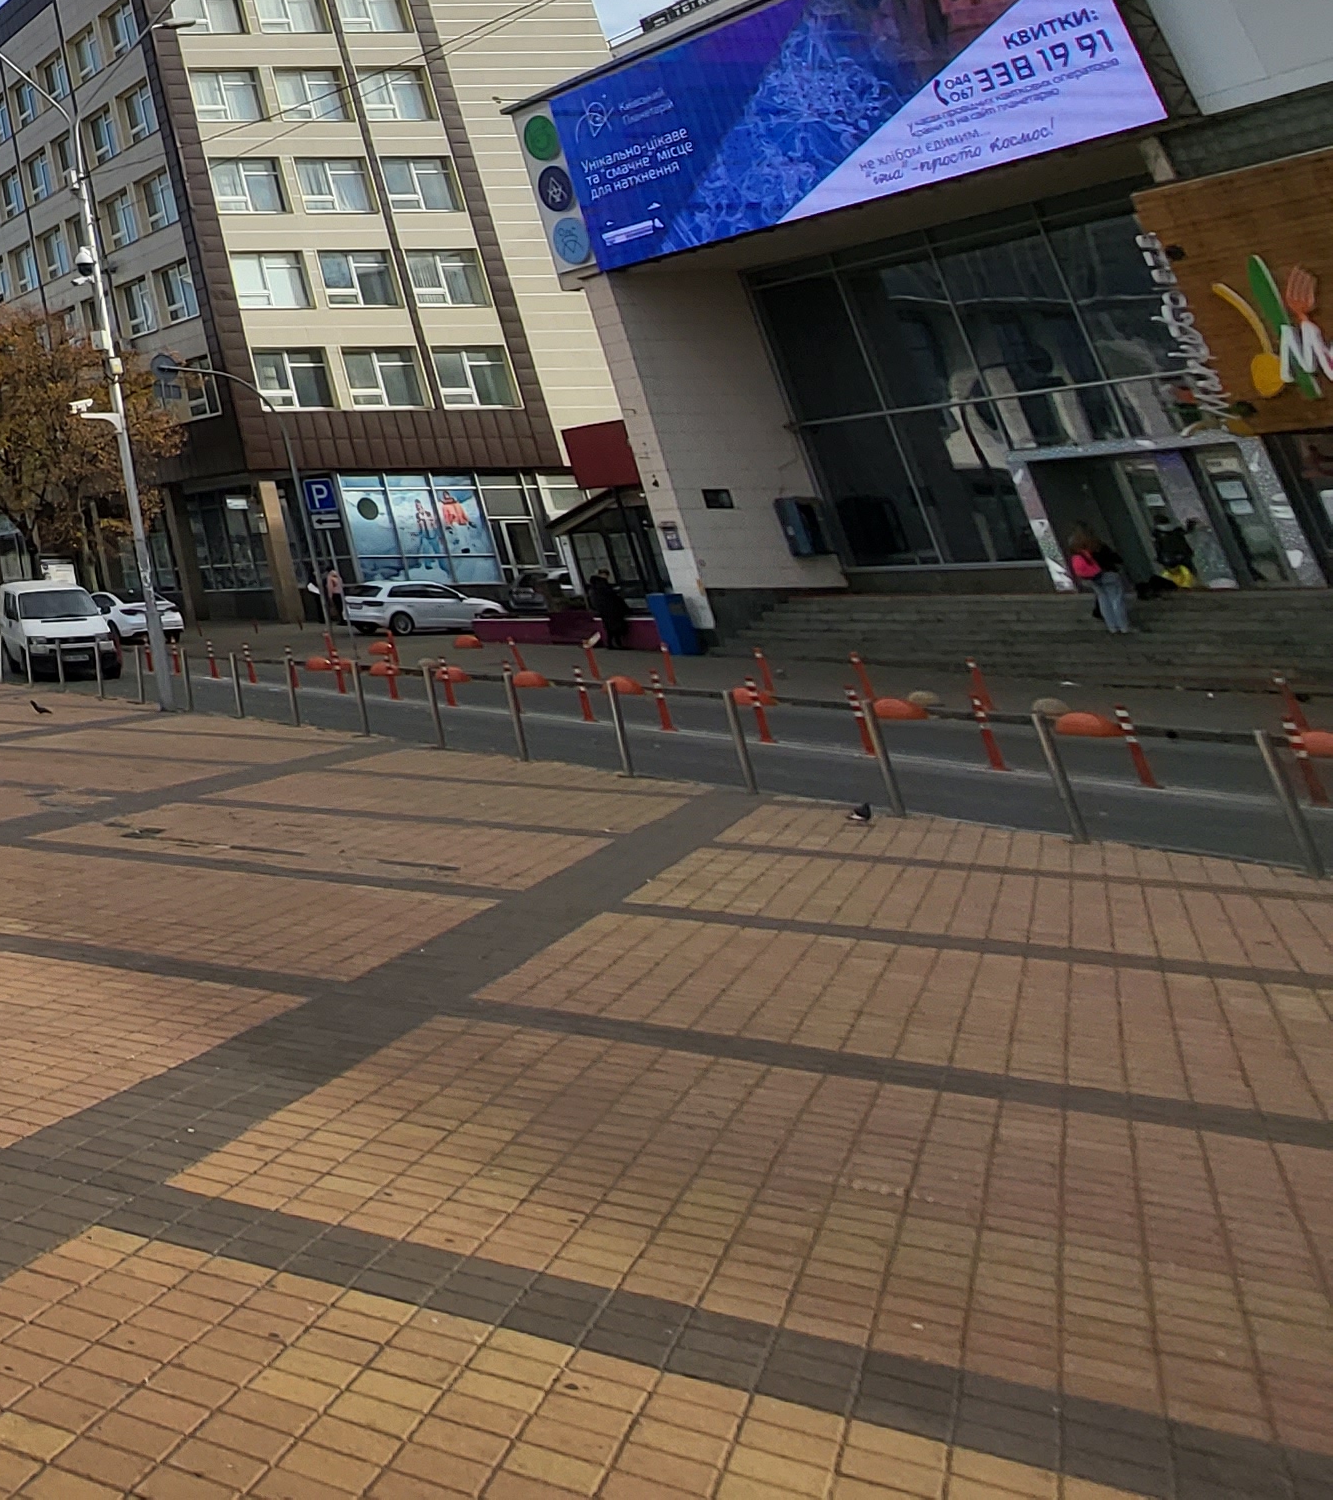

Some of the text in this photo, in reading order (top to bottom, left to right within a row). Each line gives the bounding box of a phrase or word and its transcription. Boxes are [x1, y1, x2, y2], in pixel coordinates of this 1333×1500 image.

[1002, 8, 1100, 50] КВИТКИ:
[944, 29, 1114, 93] 044 338 19 91
[949, 86, 974, 103] 067
[586, 173, 600, 186] та
[657, 141, 694, 163] місце
[591, 161, 681, 201] для натхнення
[310, 484, 329, 508] P
